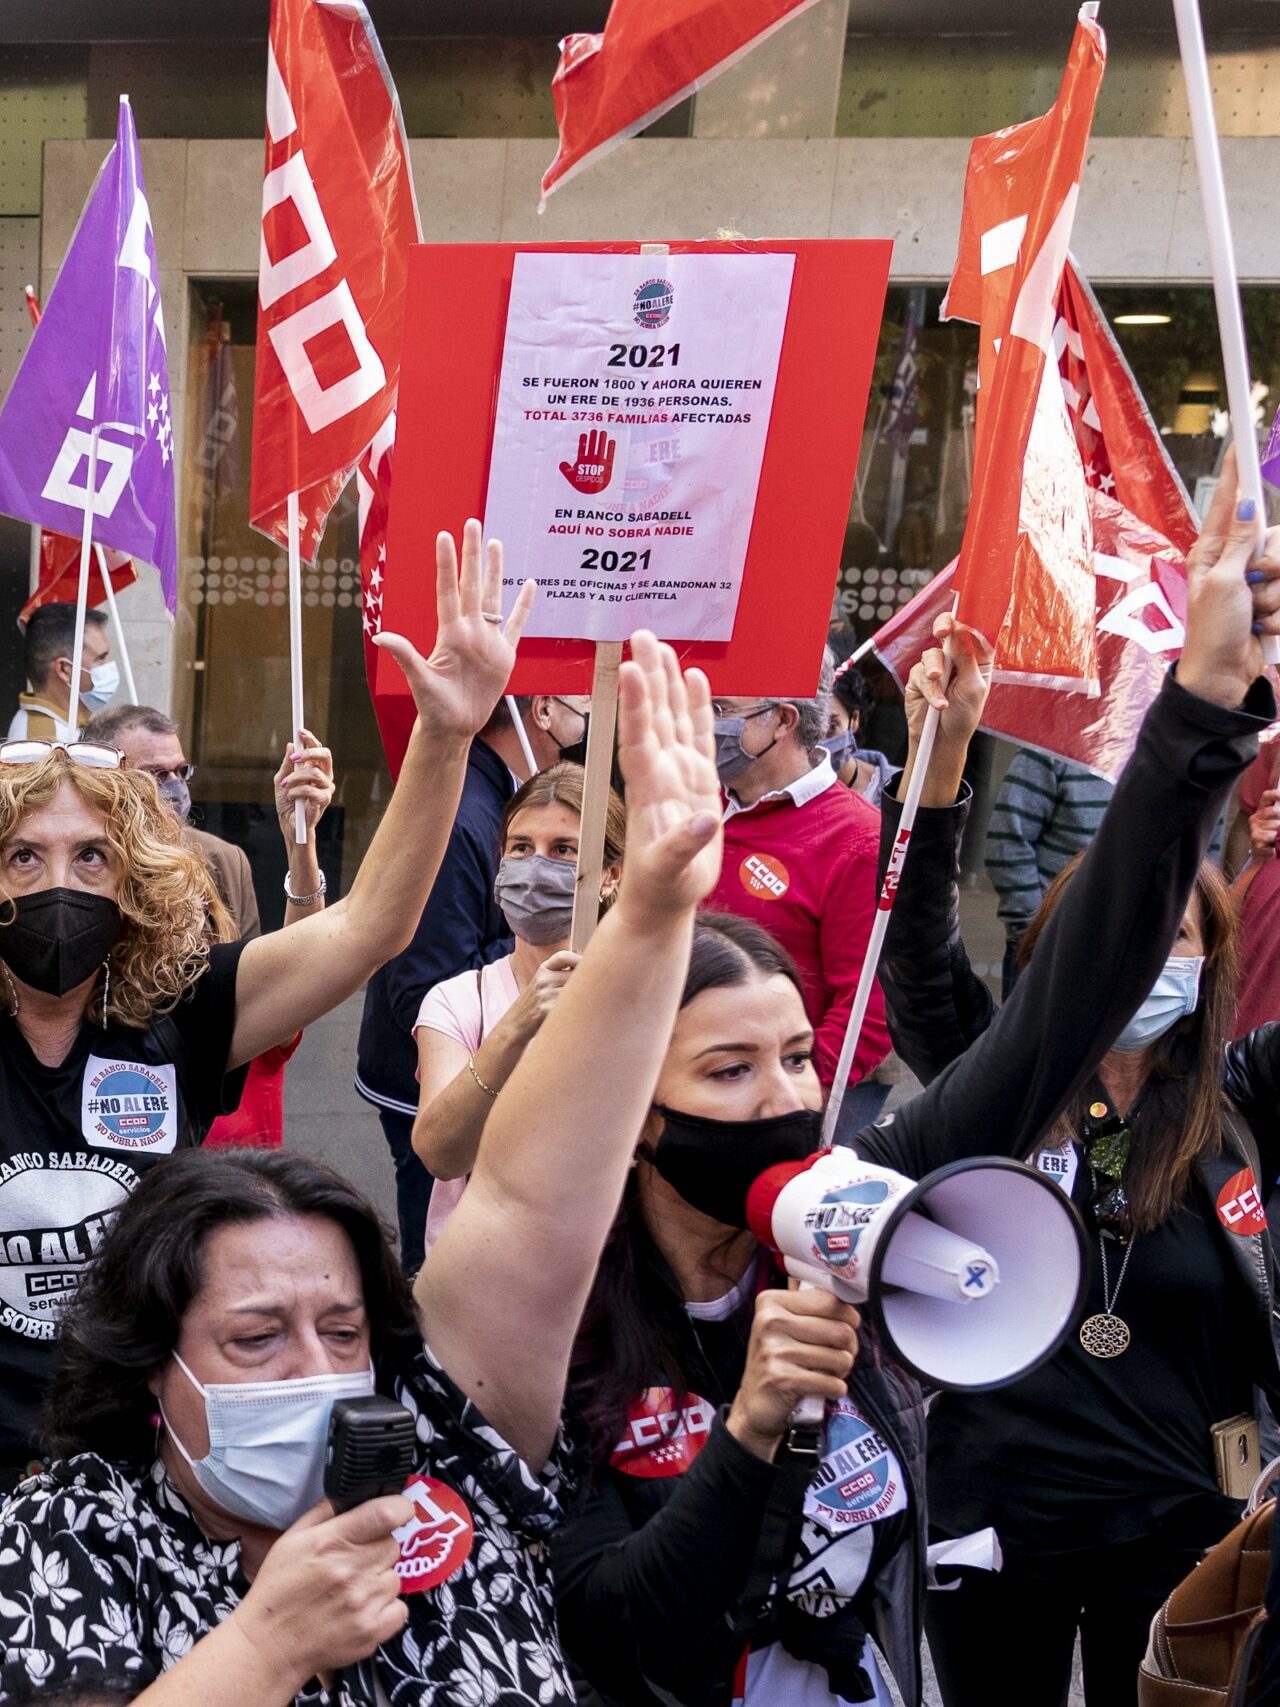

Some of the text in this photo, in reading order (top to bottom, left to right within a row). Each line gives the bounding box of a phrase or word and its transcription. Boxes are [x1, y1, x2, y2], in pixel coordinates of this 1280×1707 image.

[607, 343, 680, 368] 2021
[522, 377, 762, 391] SE FUERON 1800 Y AHORA QUIEREN
[547, 395, 732, 407] UN ERE DE 1936 PERSONAS.
[524, 411, 751, 424] TOTAL 3736 FAMILIAS AFECTADAS
[577, 464, 604, 476] STOP
[554, 508, 692, 523] EN BANCO SABADELL
[548, 523, 694, 538] AQUÍ NO SOBRA NADIE
[580, 548, 651, 572] 2021
[517, 578, 560, 586] CRRES
[563, 579, 577, 587] DE
[580, 580, 628, 590] OFICINAS
[630, 582, 636, 590] Y
[638, 580, 649, 588] SE
[652, 580, 717, 589] ABANDONAN
[719, 582, 732, 590] 32
[546, 591, 586, 599] PLAZAS
[625, 592, 677, 602] CLIENTELA
[745, 855, 788, 897] CCOO
[90, 1063, 168, 1093] EN BANCO SABADELL
[87, 1096, 169, 1114] #NO AL ERE
[119, 1117, 148, 1126] CCOO
[94, 1121, 167, 1147] NO SOBRA NADIE
[1042, 1156, 1069, 1173] ERE
[40, 1229, 86, 1264] AL
[30, 1273, 82, 1292] CCO
[834, 1450, 862, 1476] AL
[855, 1433, 888, 1463] ERE
[840, 1472, 876, 1497] CCOO
[835, 1506, 878, 1524] SOBRA
